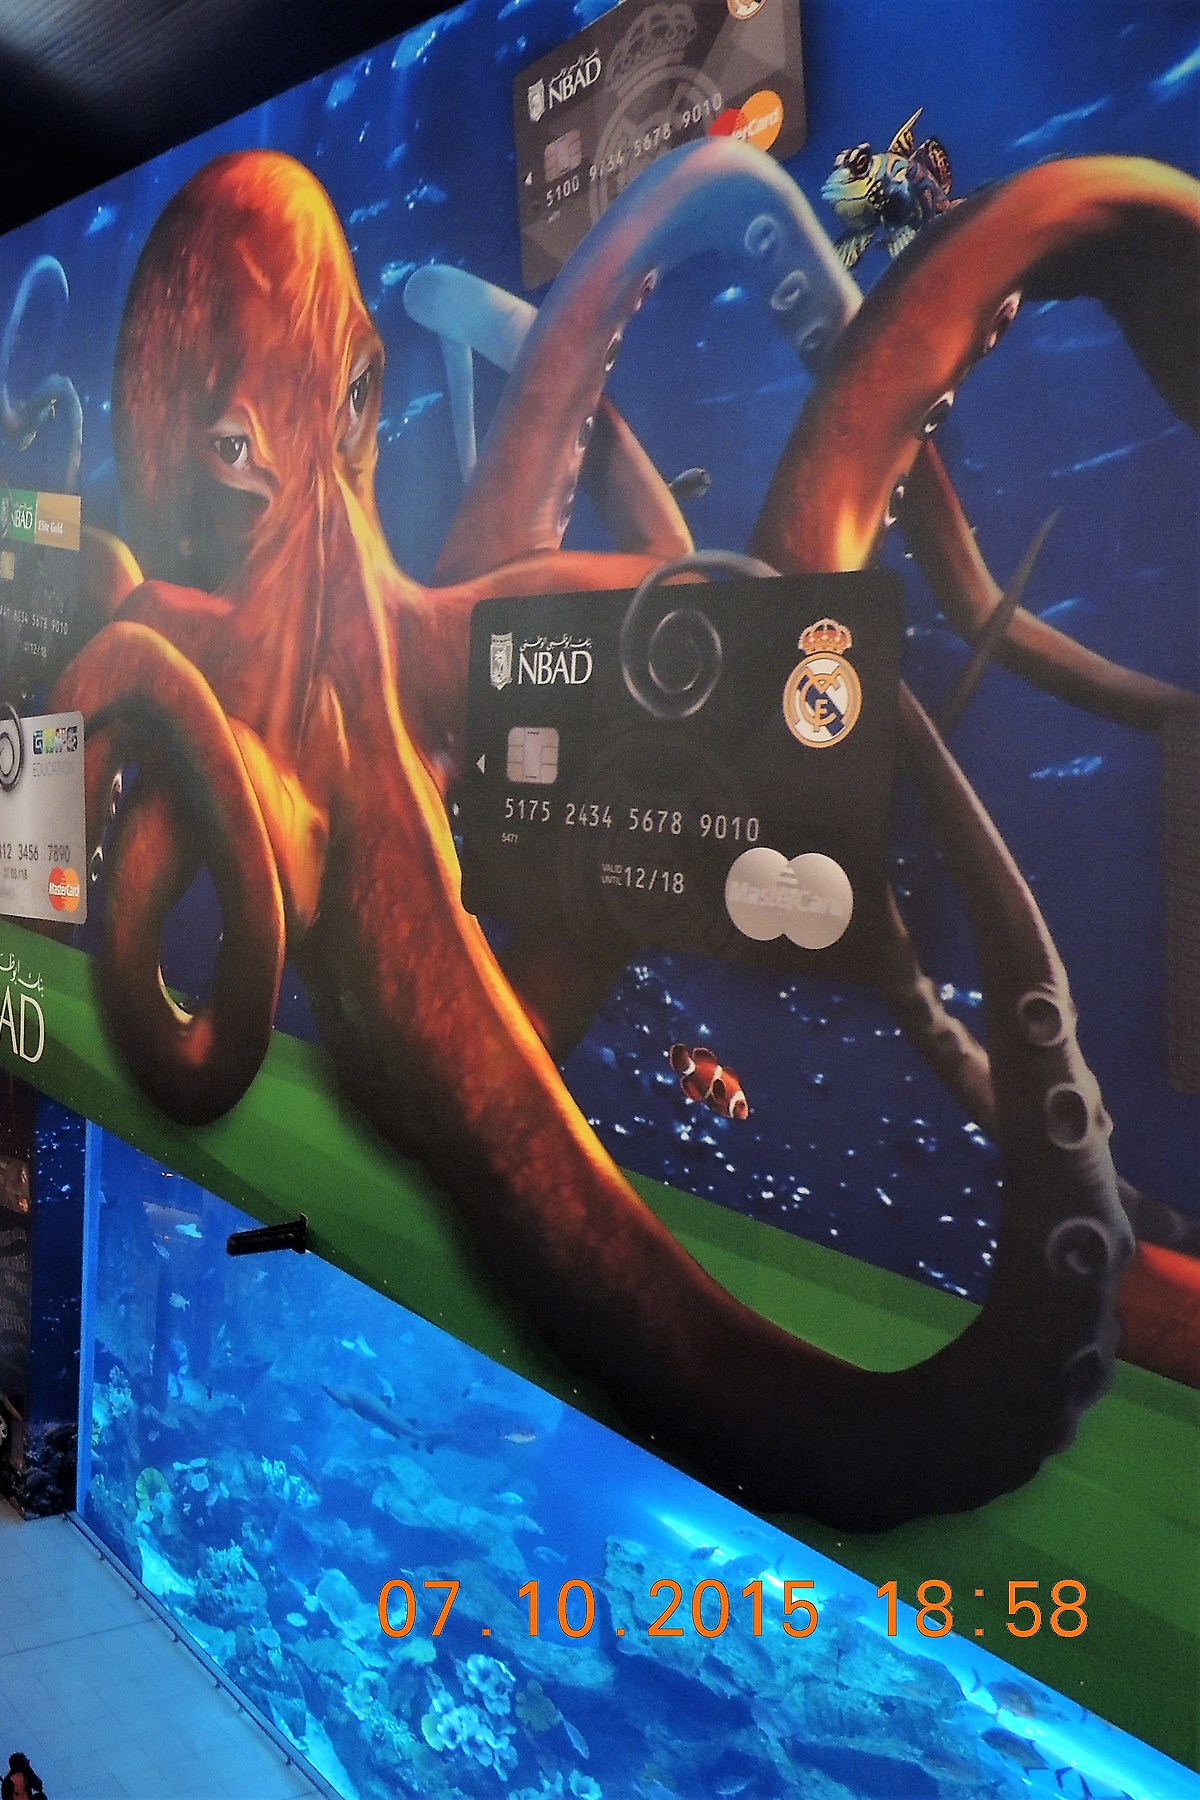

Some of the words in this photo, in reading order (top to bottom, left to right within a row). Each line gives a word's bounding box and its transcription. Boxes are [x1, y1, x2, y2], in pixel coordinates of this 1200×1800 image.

[549, 57, 602, 110] NBAD
[545, 175, 580, 208] 5100
[518, 650, 593, 685] NBAD
[505, 797, 550, 822] 5175
[565, 802, 612, 828] 2434
[629, 808, 682, 834] 5678
[700, 813, 759, 842] 9010
[18, 843, 39, 861] 3456
[47, 844, 71, 863] 7890
[48, 882, 80, 898] MasterCard
[625, 866, 685, 894] 12/18
